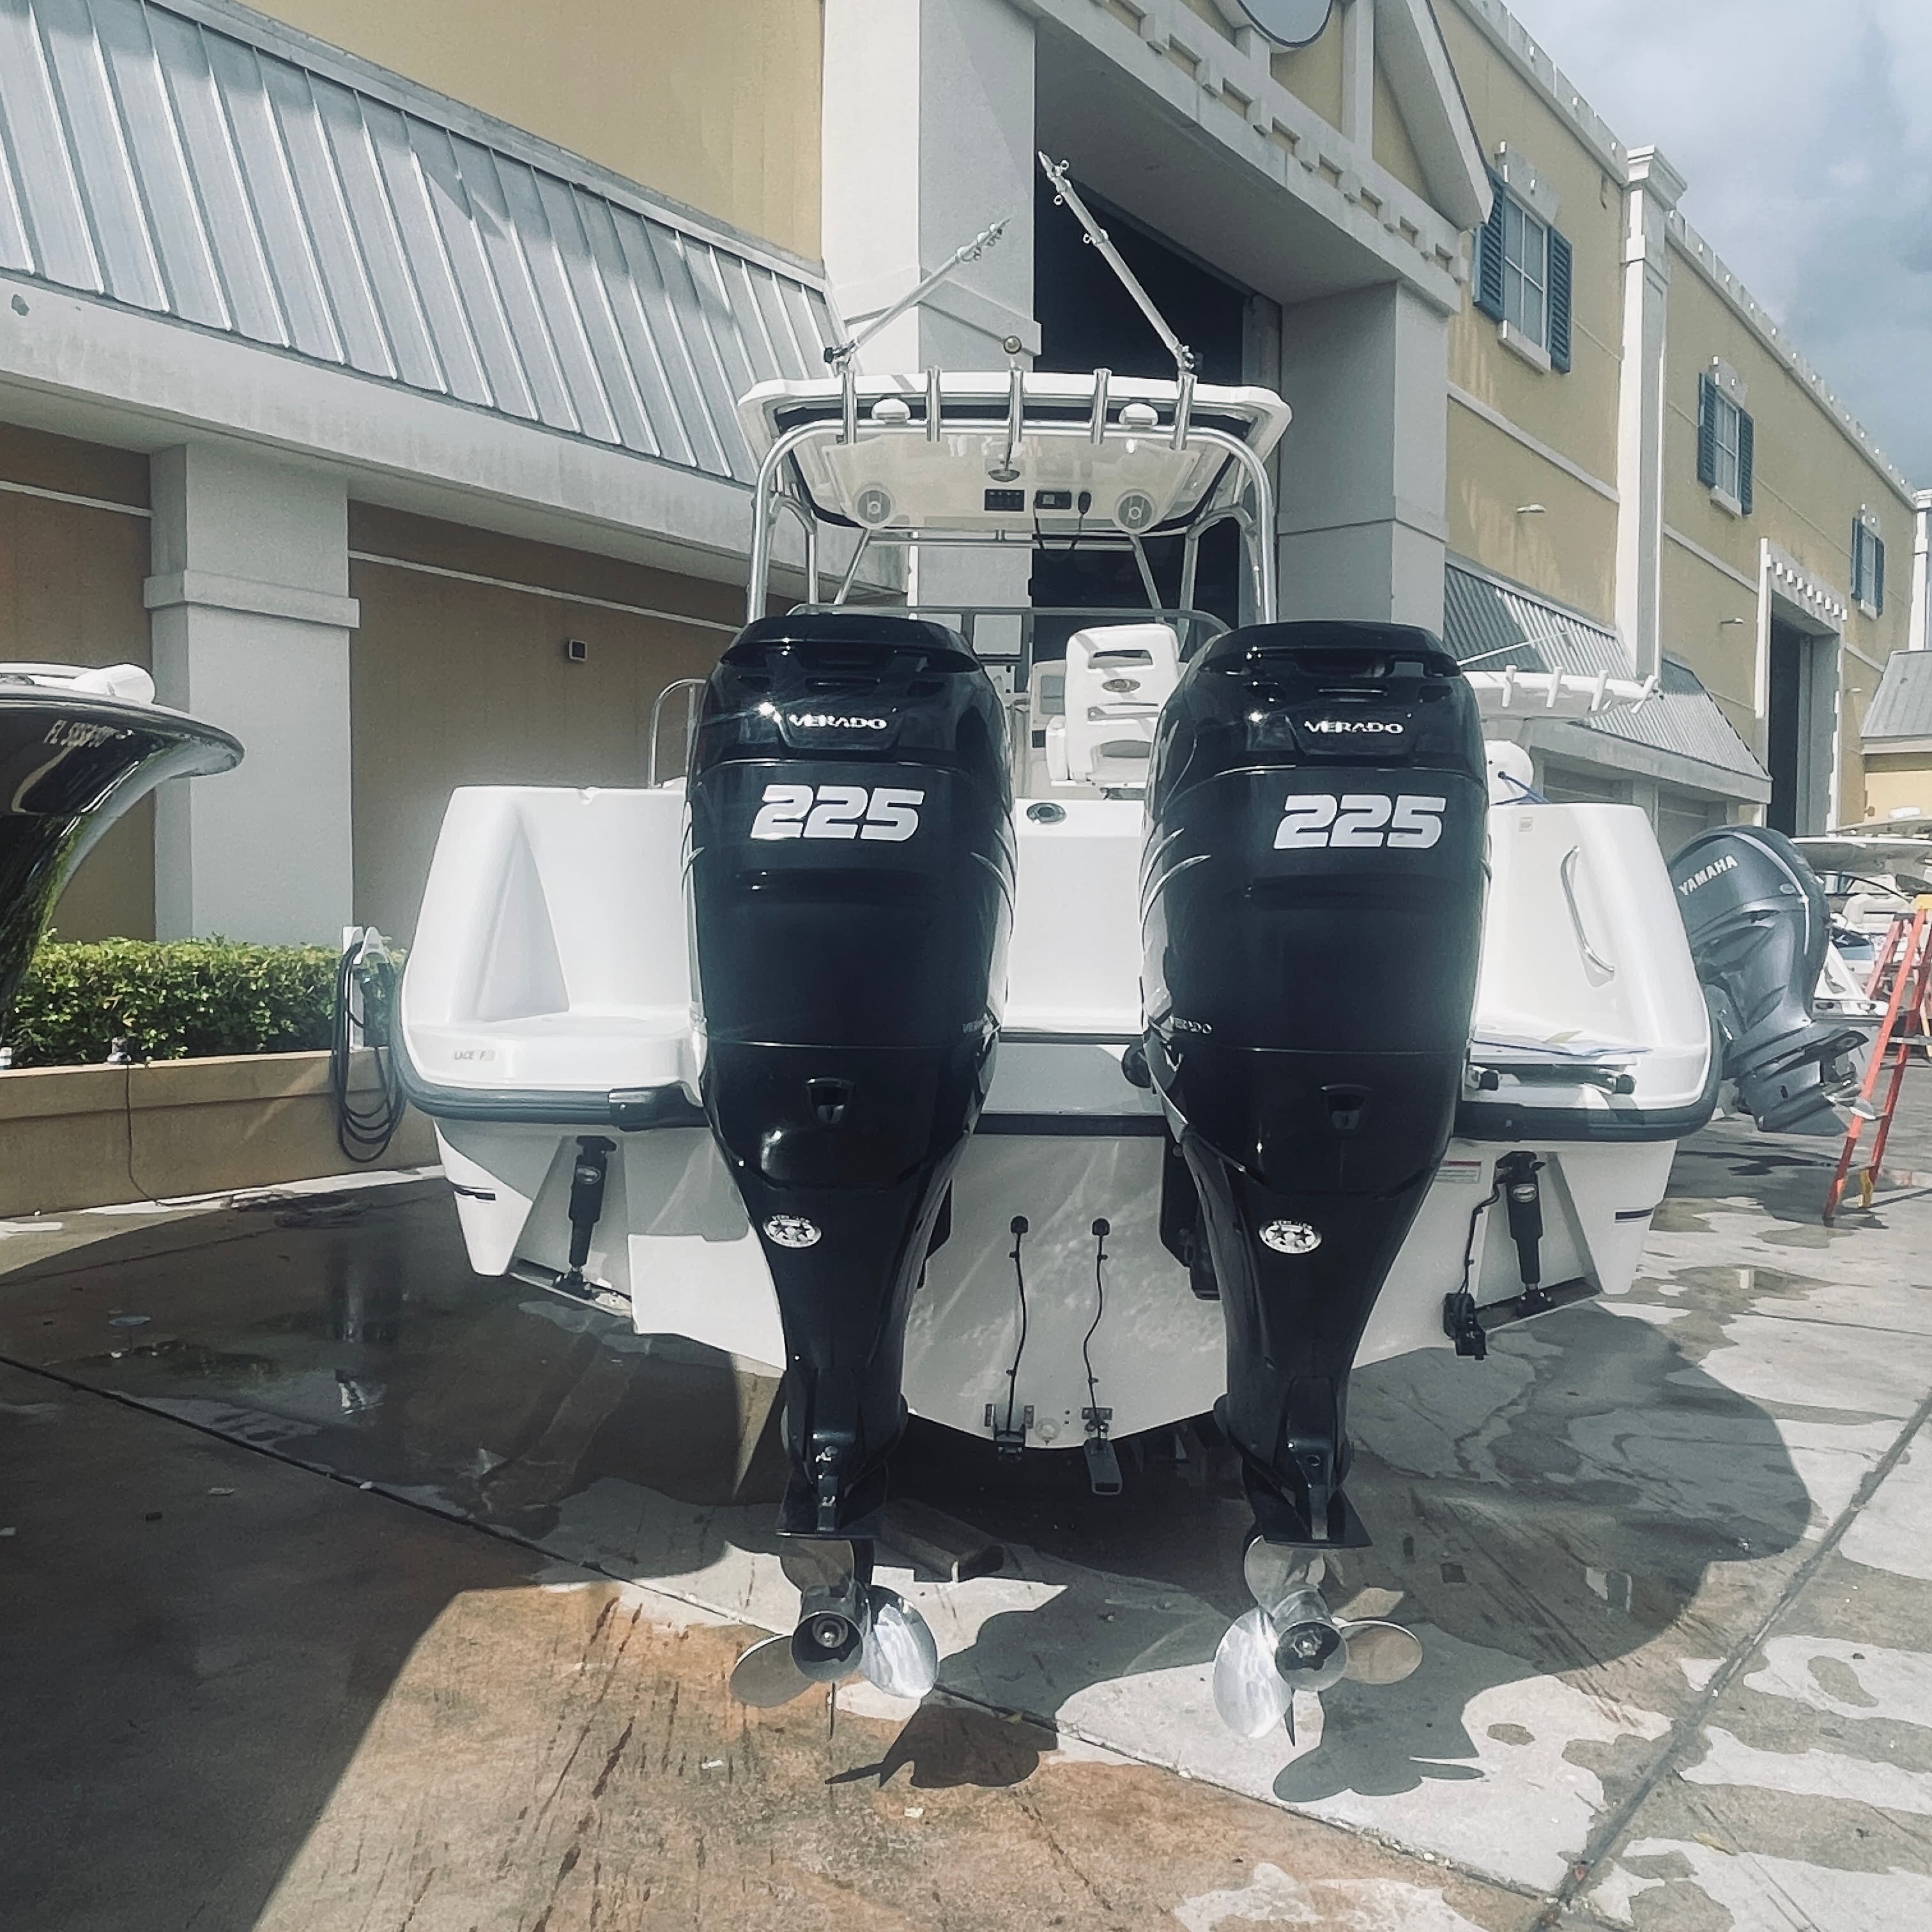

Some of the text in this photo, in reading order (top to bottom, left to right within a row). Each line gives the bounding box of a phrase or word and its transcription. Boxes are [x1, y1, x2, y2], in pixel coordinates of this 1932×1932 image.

[788, 712, 887, 730] VERADO
[1303, 719, 1404, 734] VERADO
[751, 785, 925, 841] 225
[1273, 794, 1446, 849] 225
[1678, 855, 1738, 896] YAMAHA
